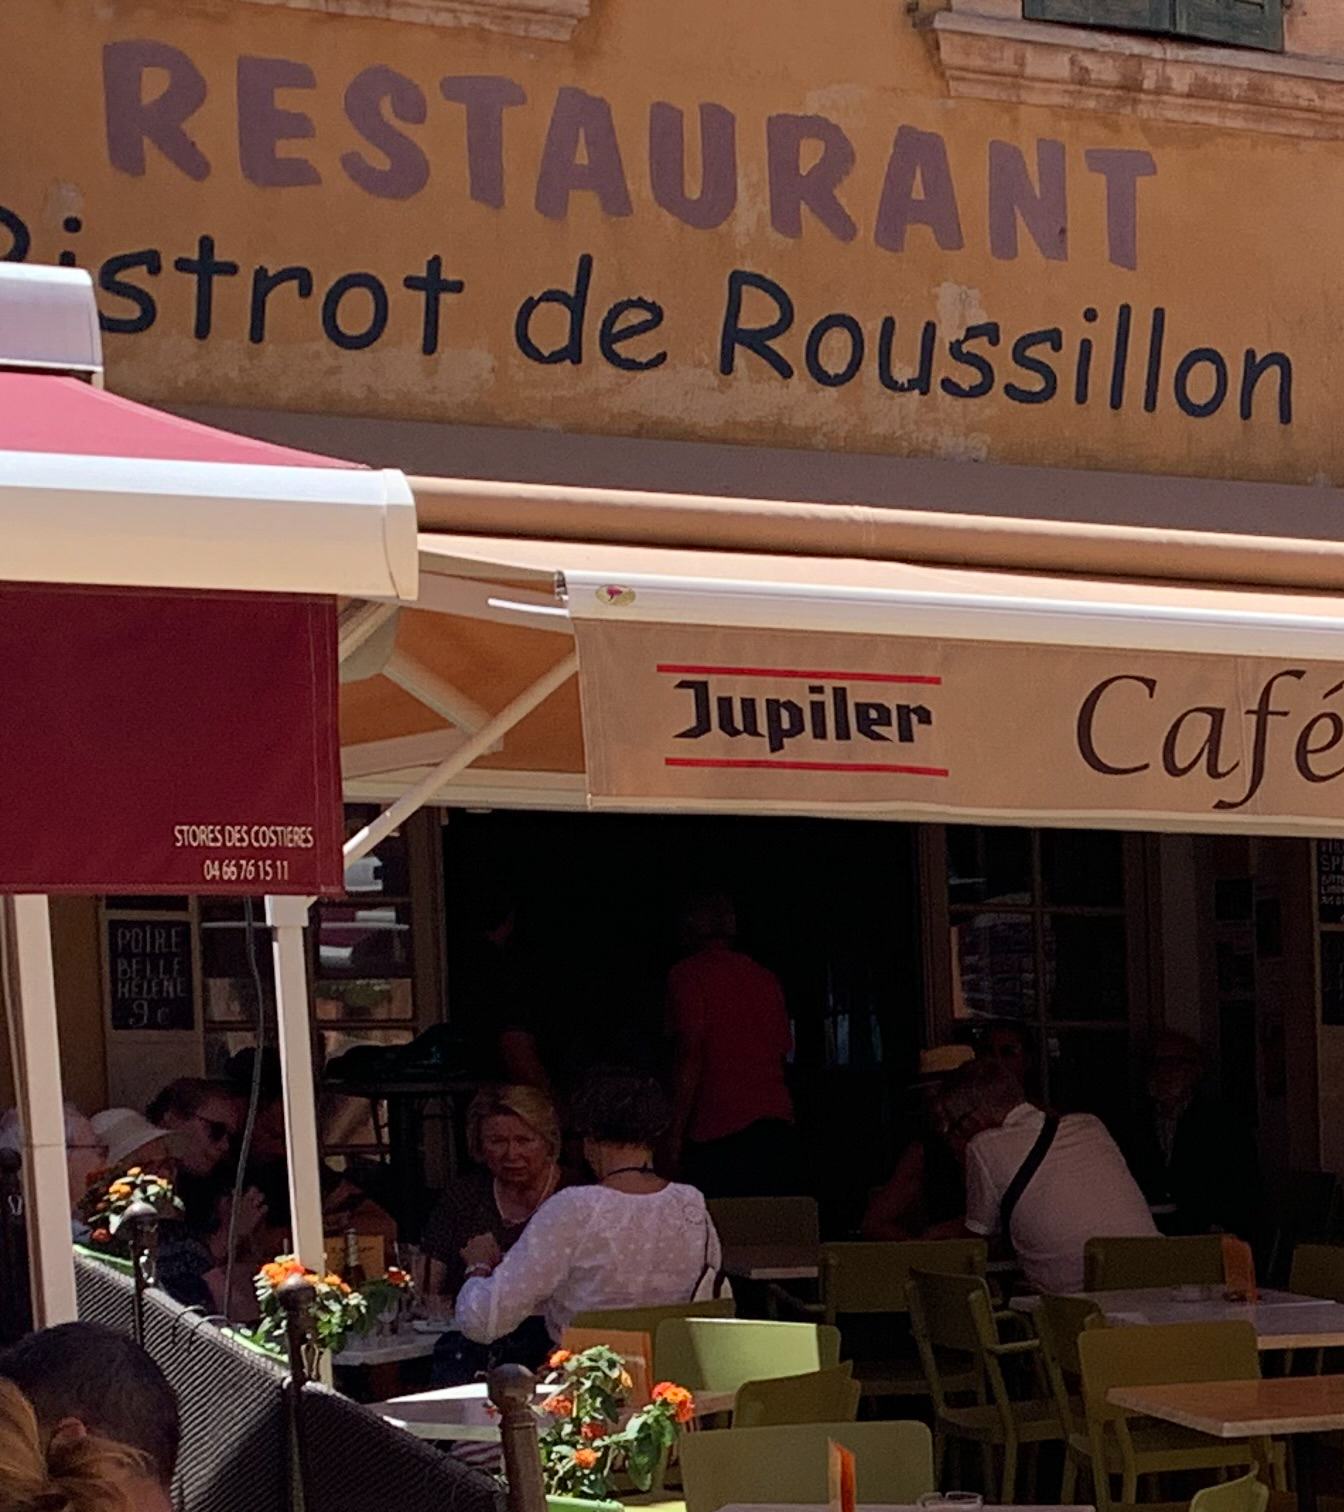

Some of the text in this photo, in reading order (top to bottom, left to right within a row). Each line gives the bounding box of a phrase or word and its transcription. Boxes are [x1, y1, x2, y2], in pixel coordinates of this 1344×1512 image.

[101, 39, 1157, 271] RESTAURANT
[0, 205, 1293, 425] strot de Roussillon
[673, 679, 933, 753] Jupiler
[174, 825, 314, 848] STORES DES COSTIERES
[204, 859, 288, 880] 04 66 76 15 11
[118, 925, 181, 954] POIRE
[118, 957, 181, 979] BELLE
